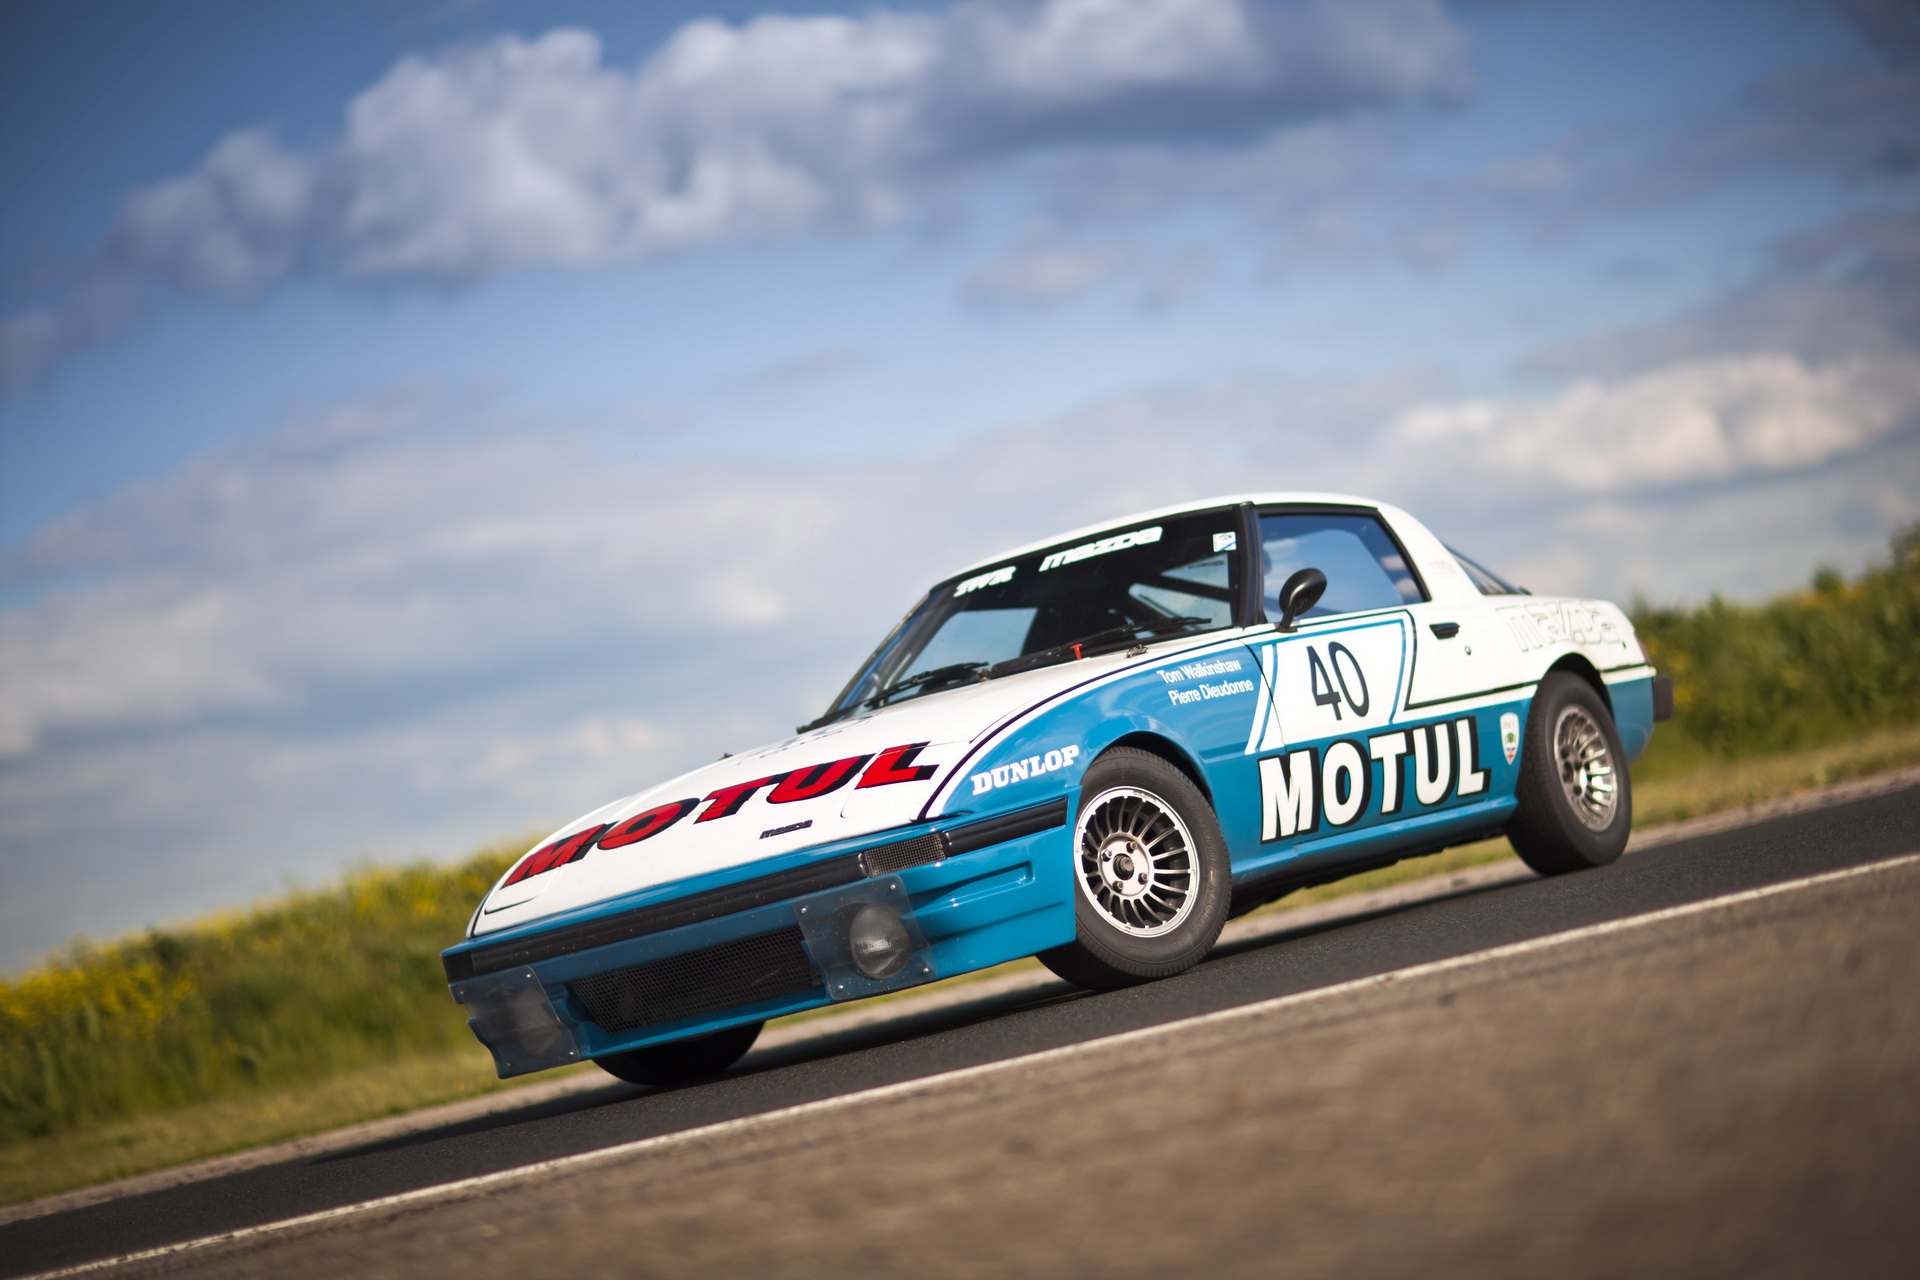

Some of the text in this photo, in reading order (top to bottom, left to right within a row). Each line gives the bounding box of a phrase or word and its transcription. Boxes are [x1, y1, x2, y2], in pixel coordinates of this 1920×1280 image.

[1156, 660, 1242, 683] Tom Walkinshaw
[1168, 680, 1254, 705] Pierre Dieudonne
[1306, 641, 1370, 721] 40
[970, 744, 1080, 795] DUNLOP
[1257, 716, 1492, 845] MOTUL
[500, 741, 940, 889] MOTUL
